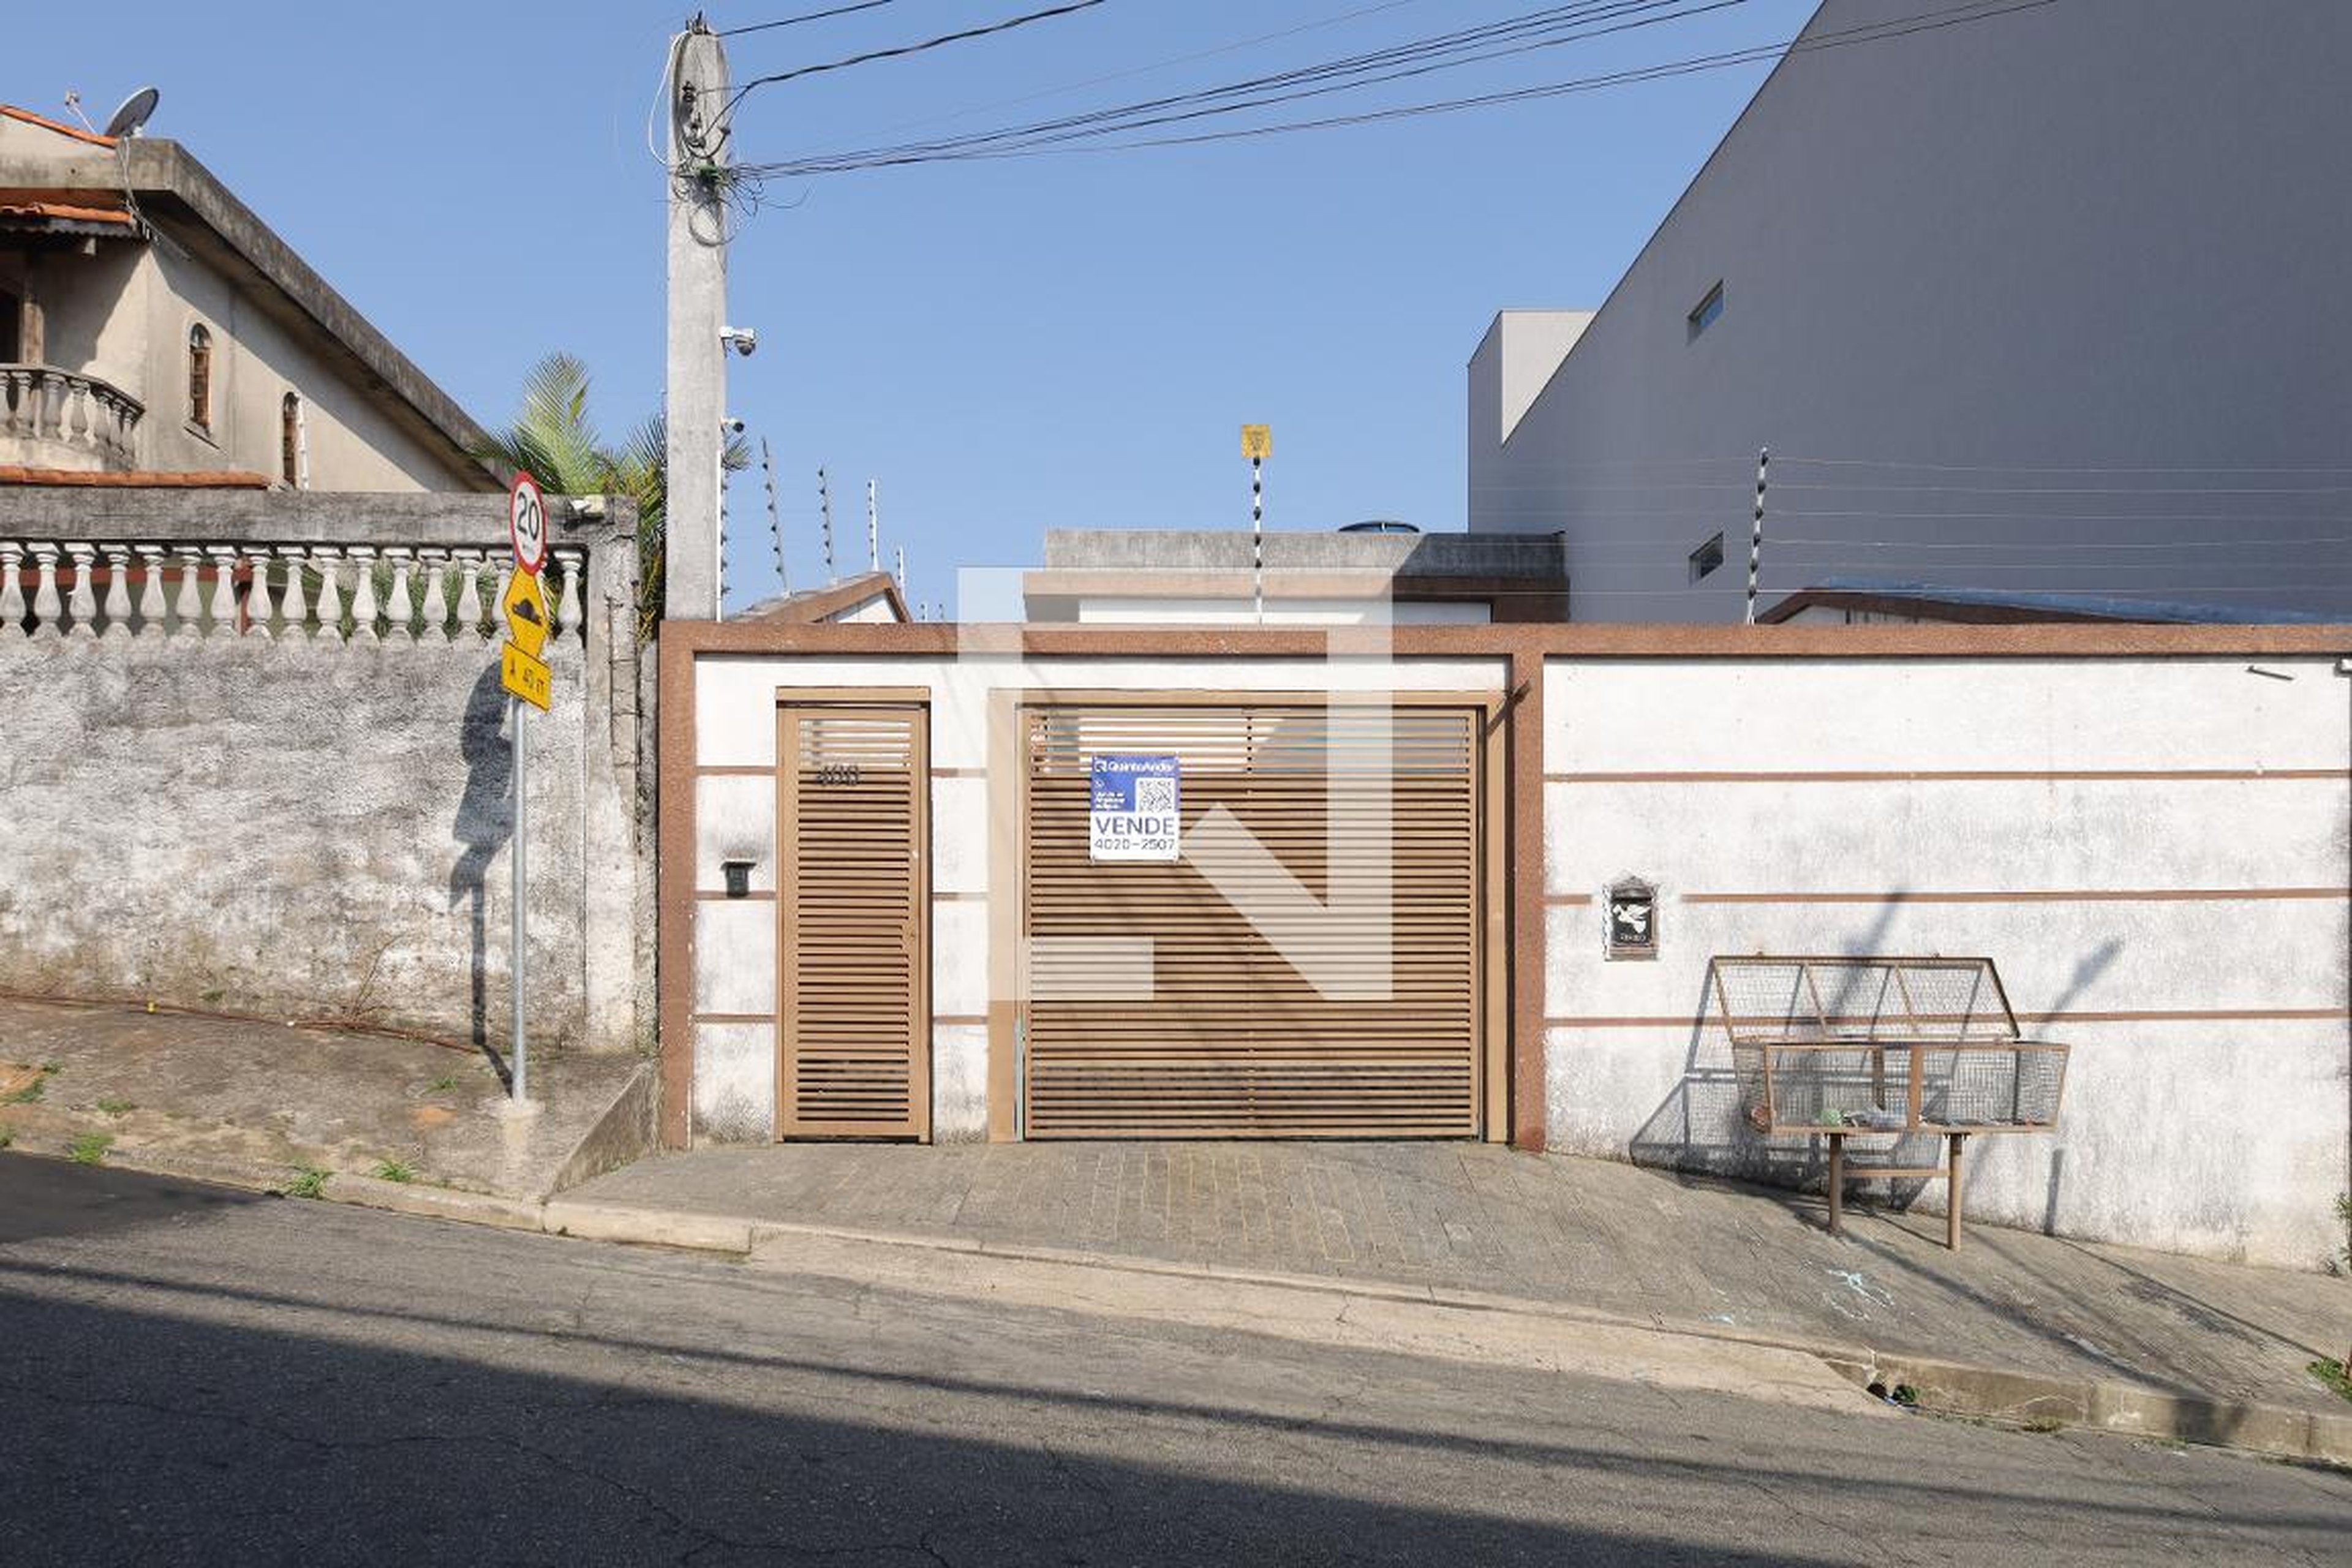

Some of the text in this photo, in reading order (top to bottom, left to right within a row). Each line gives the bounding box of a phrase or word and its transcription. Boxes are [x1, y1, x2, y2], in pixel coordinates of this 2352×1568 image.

[517, 491, 539, 541] 20
[1095, 816, 1175, 835] VENDE
[1094, 838, 1175, 850] 4020-2507
